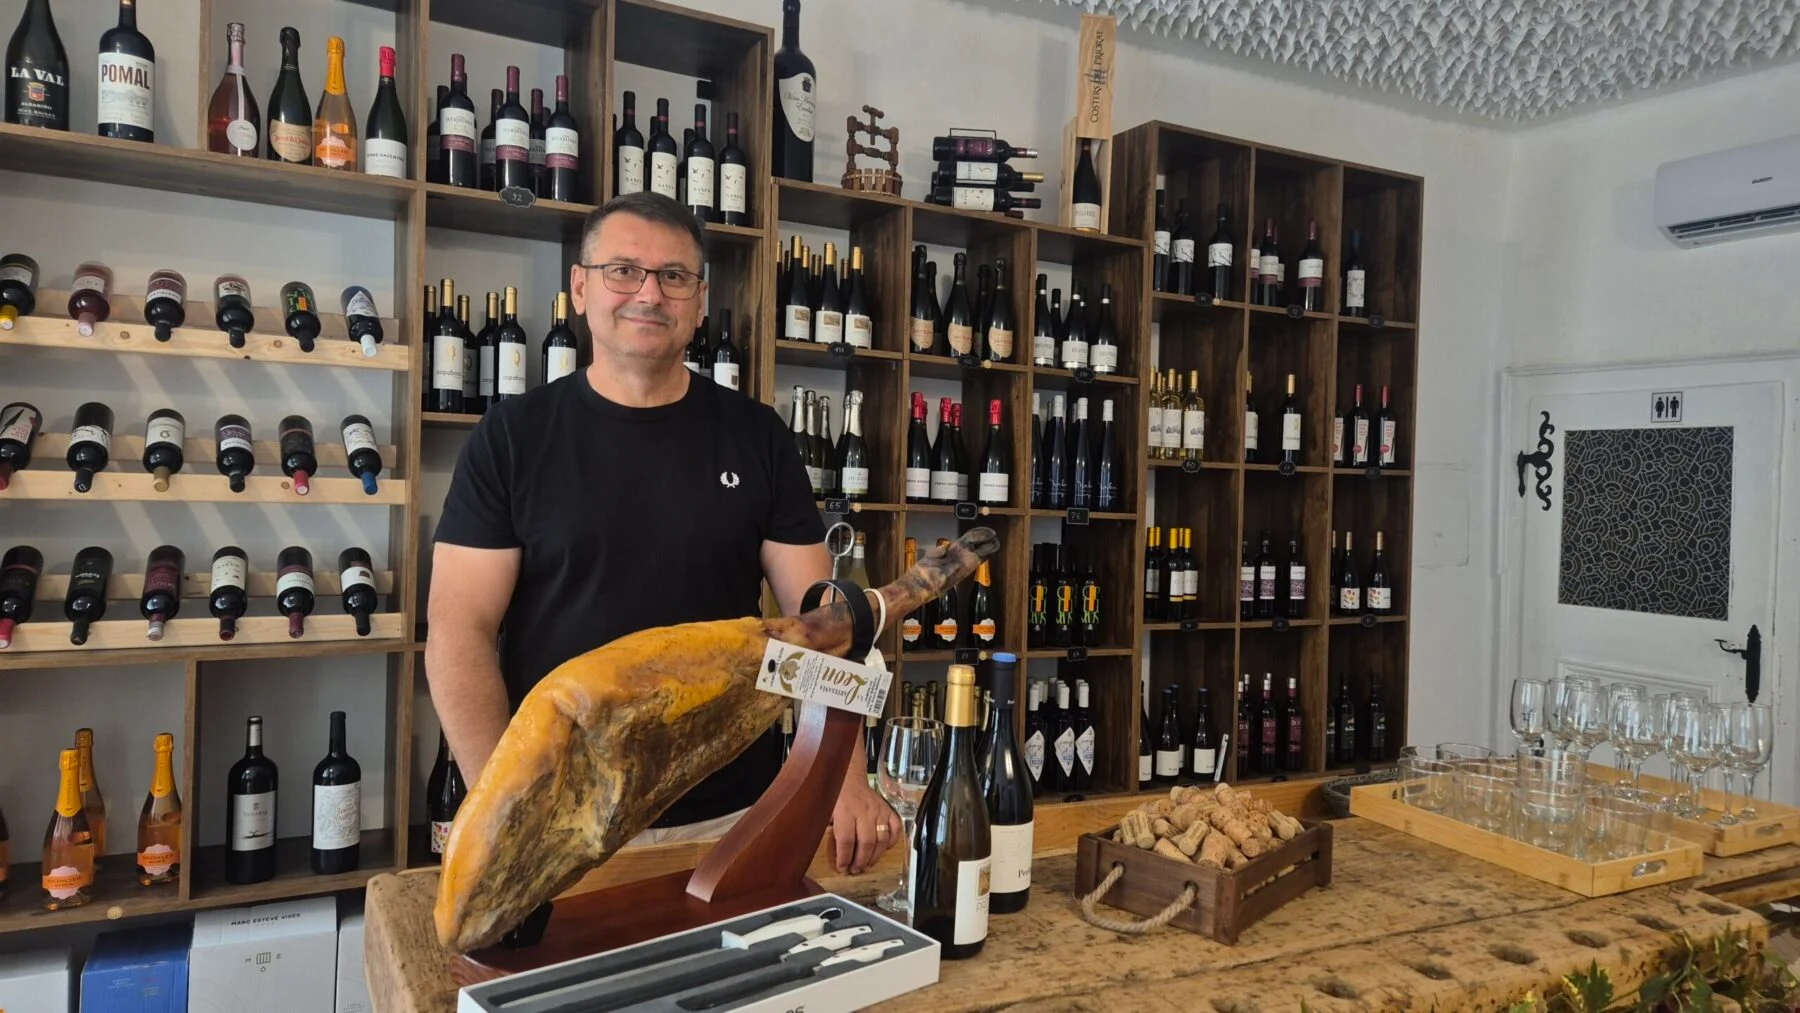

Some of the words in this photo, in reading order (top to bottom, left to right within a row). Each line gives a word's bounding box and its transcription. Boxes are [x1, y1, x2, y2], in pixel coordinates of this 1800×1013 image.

[10, 66, 32, 79] LA
[32, 68, 65, 87] VAL
[101, 63, 150, 89] POMAL
[1090, 84, 1103, 123] COSTERS
[252, 915, 279, 924] ESTEVE
[280, 912, 301, 920] VIVES
